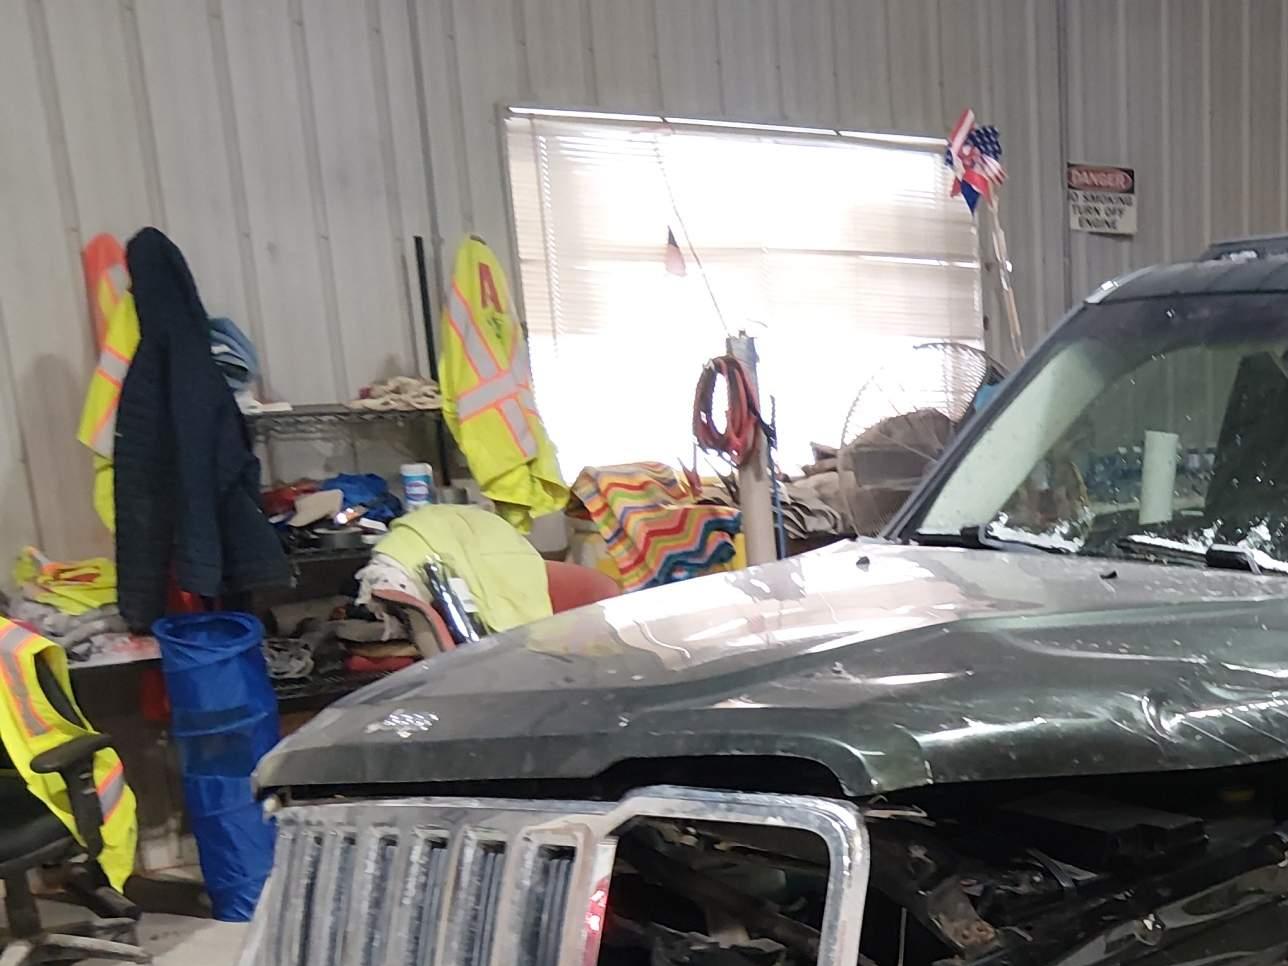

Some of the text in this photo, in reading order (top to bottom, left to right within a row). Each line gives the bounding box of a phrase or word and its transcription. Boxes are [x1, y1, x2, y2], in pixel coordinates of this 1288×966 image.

[1070, 169, 1126, 189] DANGER
[1072, 204, 1126, 219] TURN OFF
[1078, 216, 1119, 231] ENGINE
